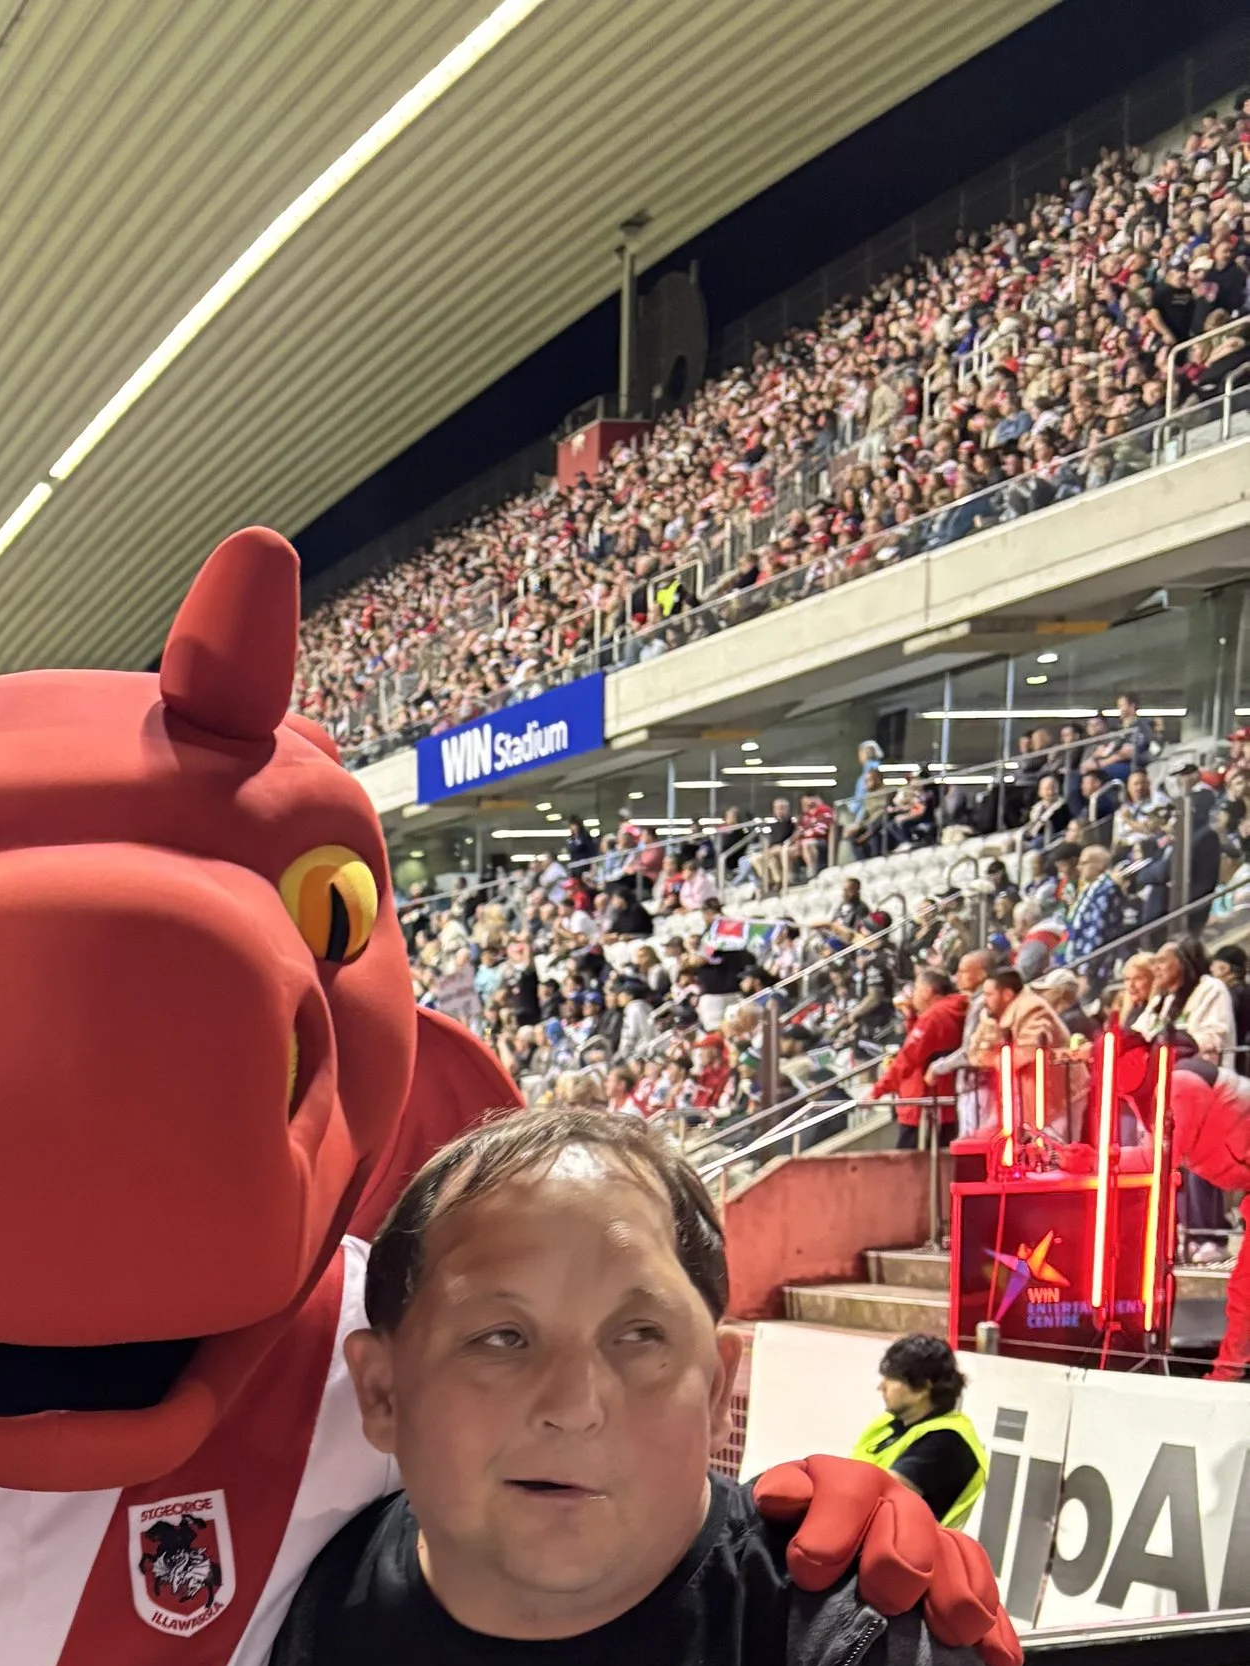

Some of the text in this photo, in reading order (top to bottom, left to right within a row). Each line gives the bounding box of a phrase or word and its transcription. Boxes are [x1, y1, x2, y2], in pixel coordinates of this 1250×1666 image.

[441, 720, 568, 788] WIN Stadium
[1027, 1287, 1060, 1304] WIN
[1027, 1313, 1080, 1328] CENTRE
